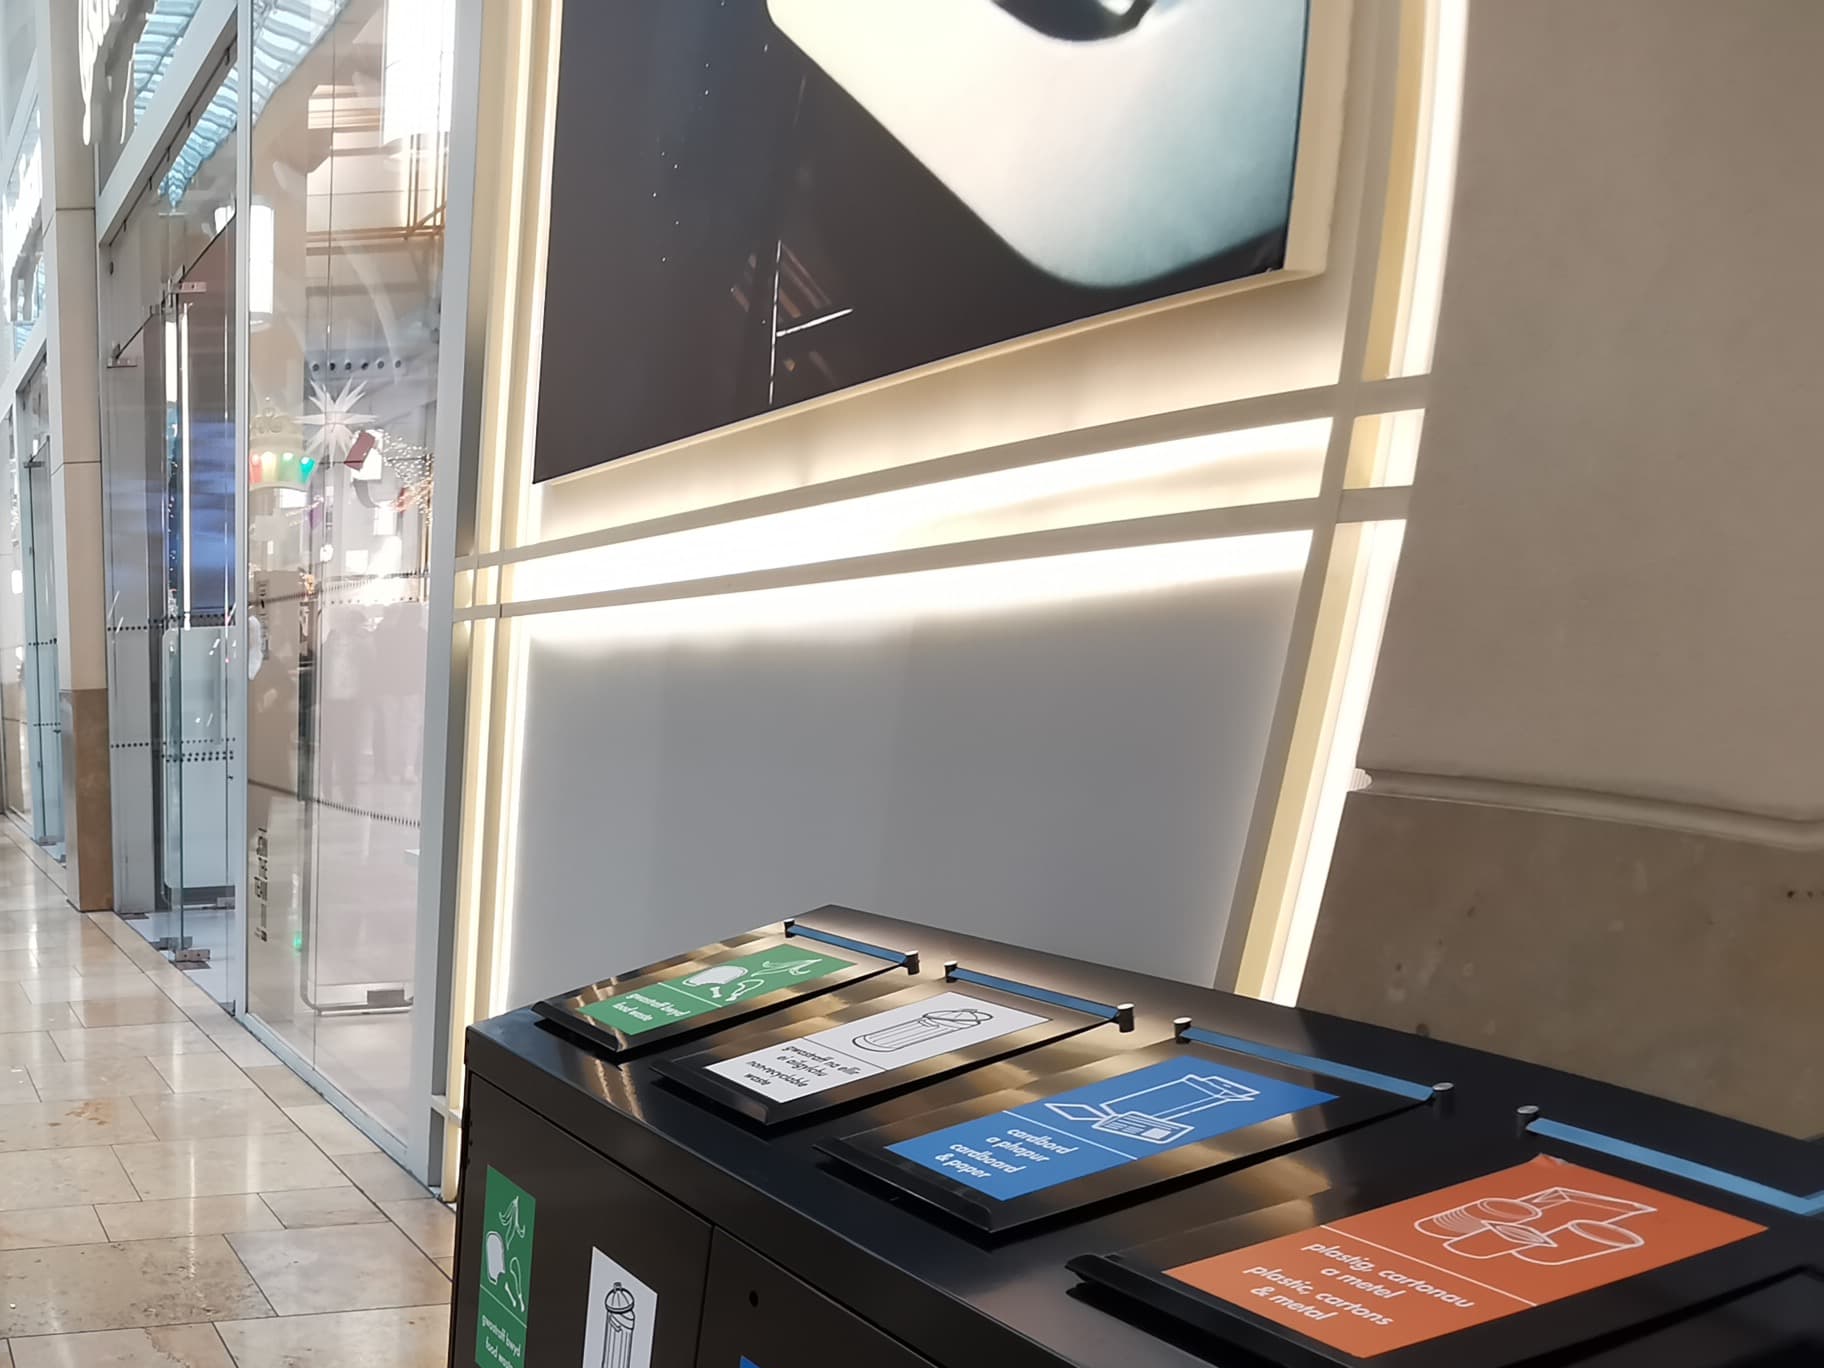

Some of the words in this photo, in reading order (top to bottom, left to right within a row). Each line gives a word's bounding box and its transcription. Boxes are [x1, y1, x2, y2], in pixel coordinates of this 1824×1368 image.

[613, 1002, 639, 1013] food
[628, 1010, 653, 1022] waste
[744, 1073, 772, 1086] waste
[985, 1136, 1001, 1144] a
[991, 1139, 1050, 1163] phapur
[1007, 1129, 1079, 1155] cardbord
[934, 1153, 954, 1162] &
[942, 1157, 992, 1178] paper
[949, 1144, 1027, 1173] cardboard
[1301, 1243, 1376, 1272] plastig,
[1378, 1269, 1475, 1308] cartonau
[1320, 1267, 1340, 1276] a
[1336, 1274, 1407, 1299] metel
[1242, 1266, 1313, 1295] plastic,
[1315, 1293, 1394, 1326] cartons
[1250, 1286, 1275, 1297] &
[1269, 1294, 1338, 1321] metal
[485, 1336, 499, 1358] food
